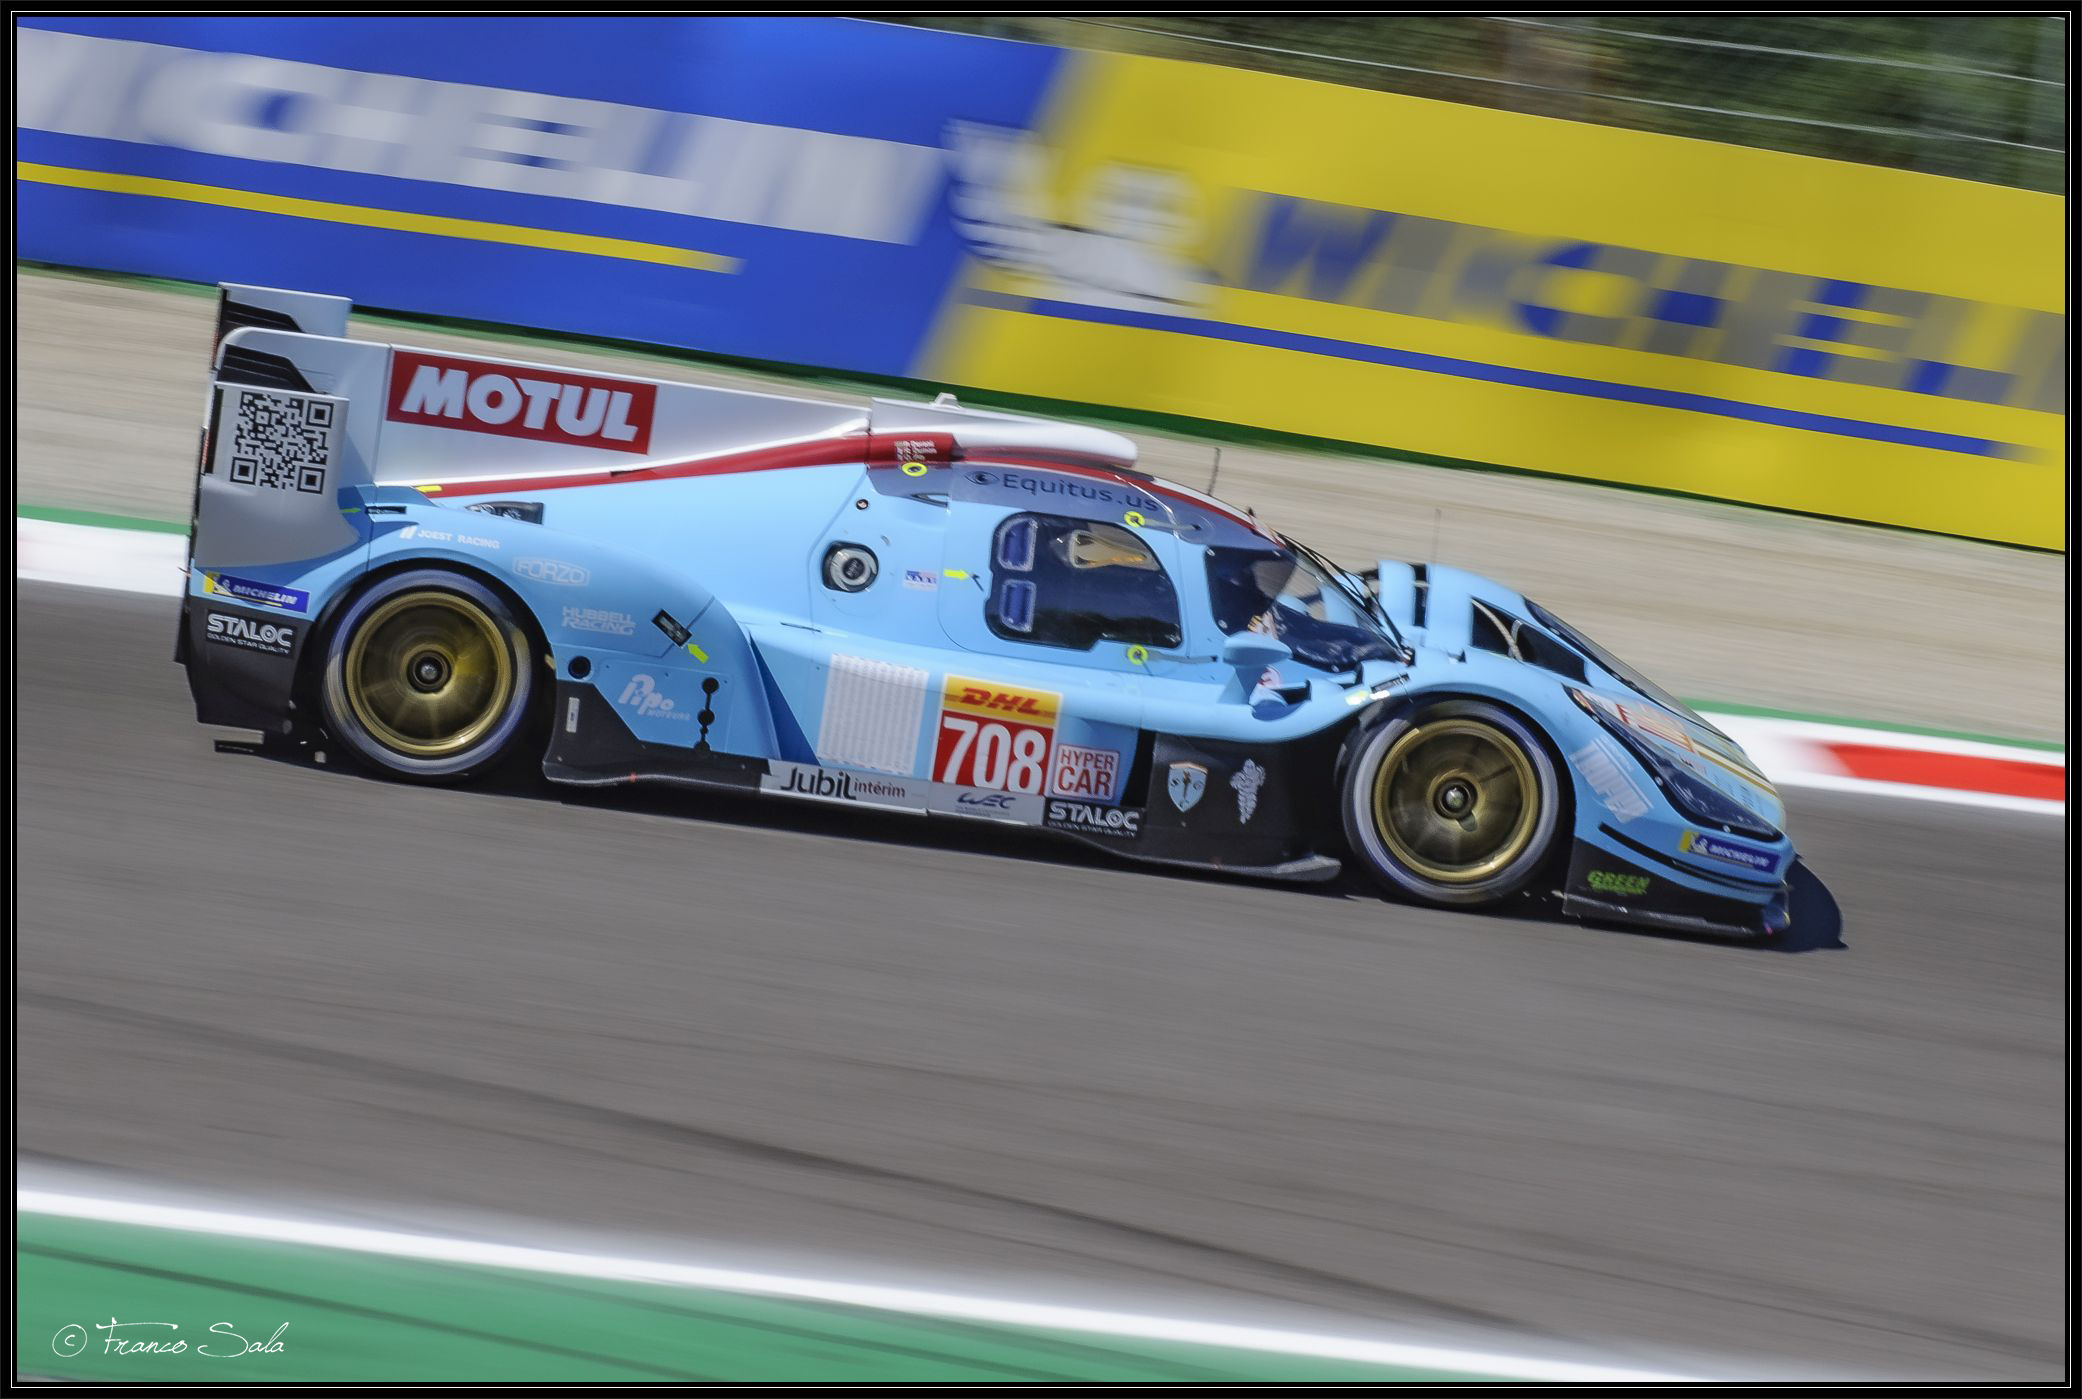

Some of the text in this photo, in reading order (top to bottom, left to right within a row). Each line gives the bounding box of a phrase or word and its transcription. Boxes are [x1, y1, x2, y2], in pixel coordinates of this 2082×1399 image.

[401, 365, 641, 442] MOTUL
[1003, 473, 1158, 512] Equitus.us
[418, 529, 499, 549] JOEST RACING
[517, 560, 585, 584] FORZO
[232, 584, 298, 605] MICHELIN
[562, 606, 632, 622] HUBBELL
[562, 617, 637, 636] RACING
[207, 613, 293, 648] STALOC
[237, 639, 258, 649] STAR
[618, 673, 674, 716] Pipo
[960, 687, 1041, 715] DHL
[942, 716, 1047, 795] 708
[1060, 749, 1115, 770] HYPER
[781, 767, 905, 800] Jubil intérim
[1057, 765, 1112, 797] CAR
[957, 792, 1016, 809] WEC
[1049, 801, 1140, 831] STALOC
